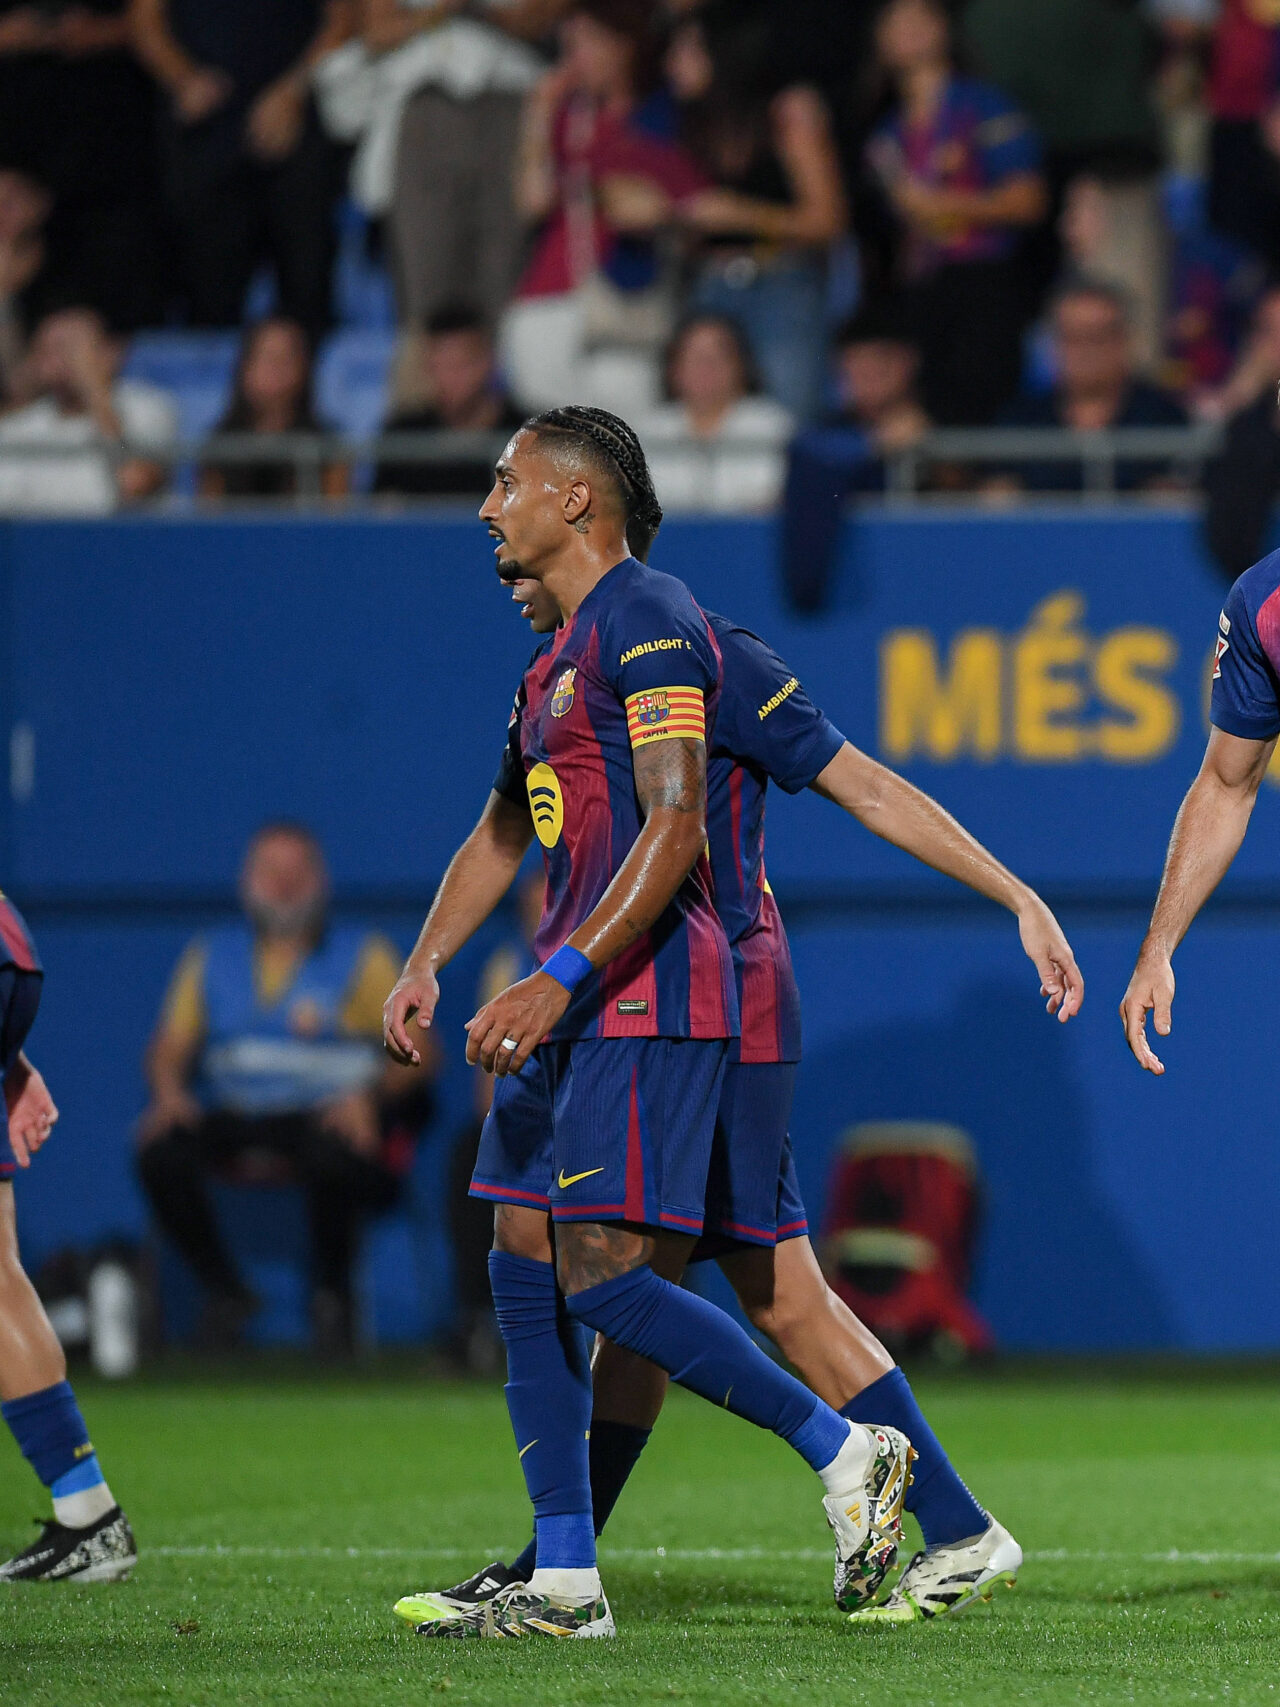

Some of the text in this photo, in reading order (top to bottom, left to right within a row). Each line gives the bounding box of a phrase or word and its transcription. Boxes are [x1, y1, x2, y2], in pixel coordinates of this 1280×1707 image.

[620, 639, 683, 665] AMBILIGHT
[880, 590, 1176, 763] MÉS
[758, 677, 799, 720] AMBILIGH
[643, 727, 668, 739] CAPITÀ
